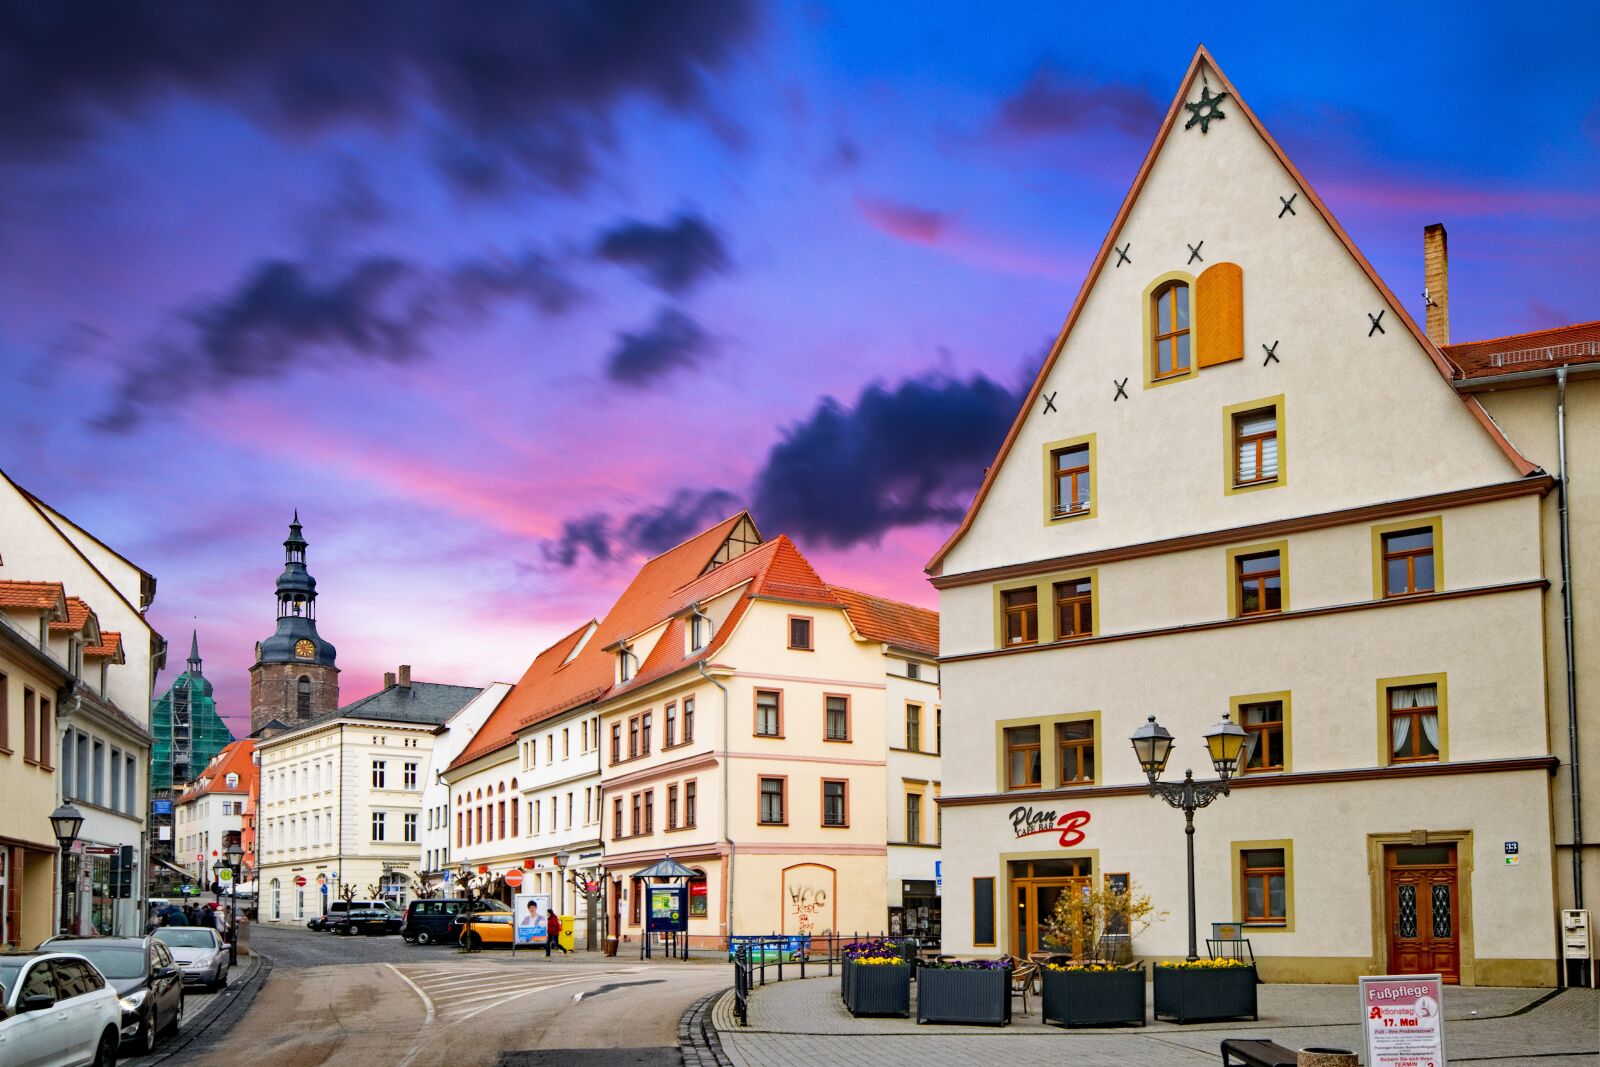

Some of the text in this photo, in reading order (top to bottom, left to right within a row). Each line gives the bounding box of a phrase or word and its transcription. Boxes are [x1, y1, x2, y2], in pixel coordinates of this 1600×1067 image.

[1009, 806, 1091, 847] Plan B
[1039, 822, 1054, 831] BAR
[1369, 986, 1429, 1000] Fußpflege
[1383, 1018, 1418, 1027] 17. Mai
